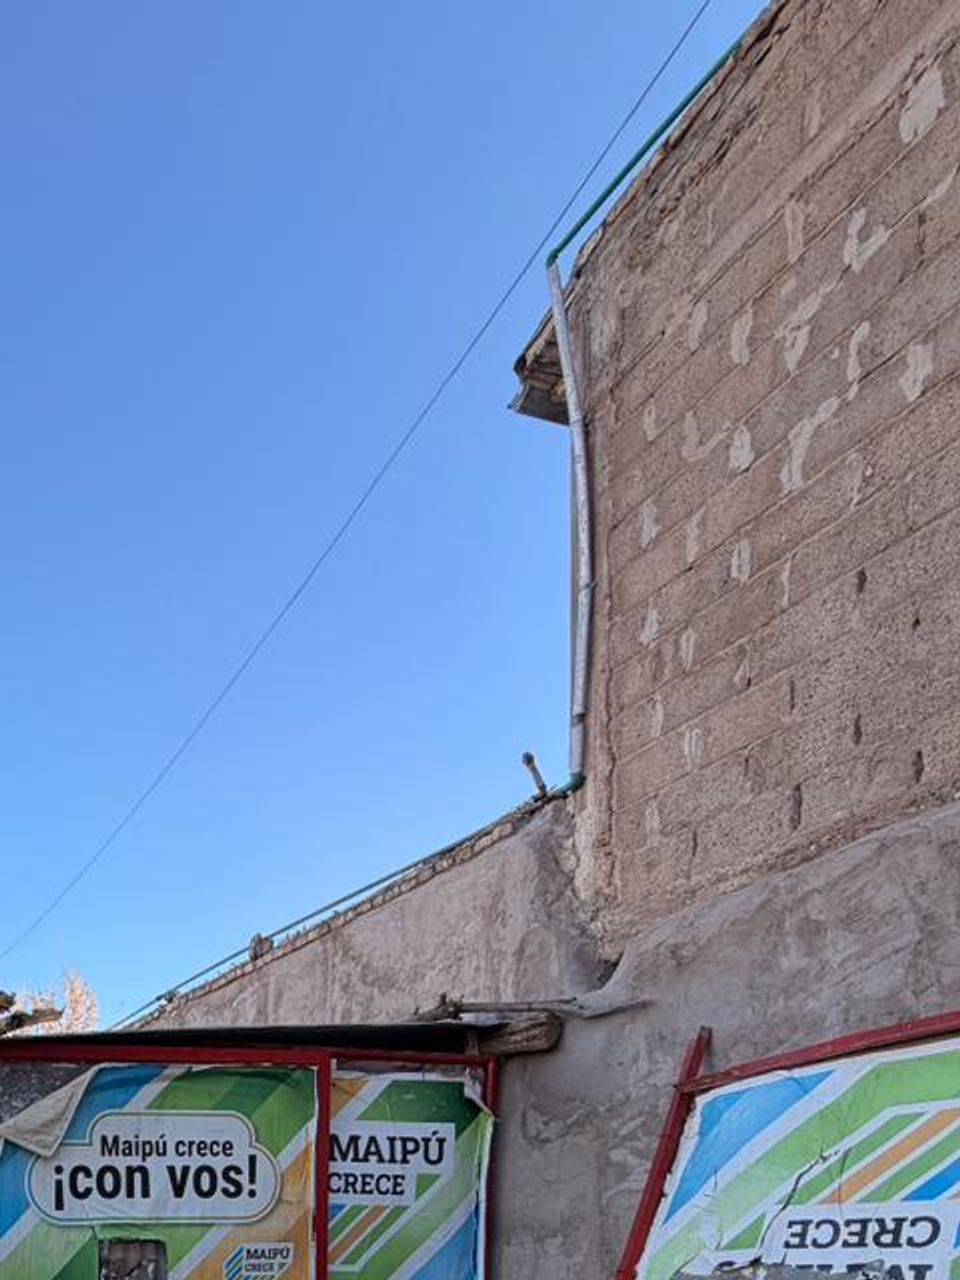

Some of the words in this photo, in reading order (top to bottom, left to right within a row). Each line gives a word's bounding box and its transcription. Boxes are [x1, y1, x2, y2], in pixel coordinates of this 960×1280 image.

[101, 1134, 167, 1161] Maipú
[174, 1140, 234, 1158] crece
[329, 1130, 447, 1166] MAIPÚ
[53, 1165, 151, 1211] ¡con
[166, 1154, 257, 1199] vos!
[328, 1172, 406, 1196] CRECE
[784, 1216, 941, 1250] CRECE
